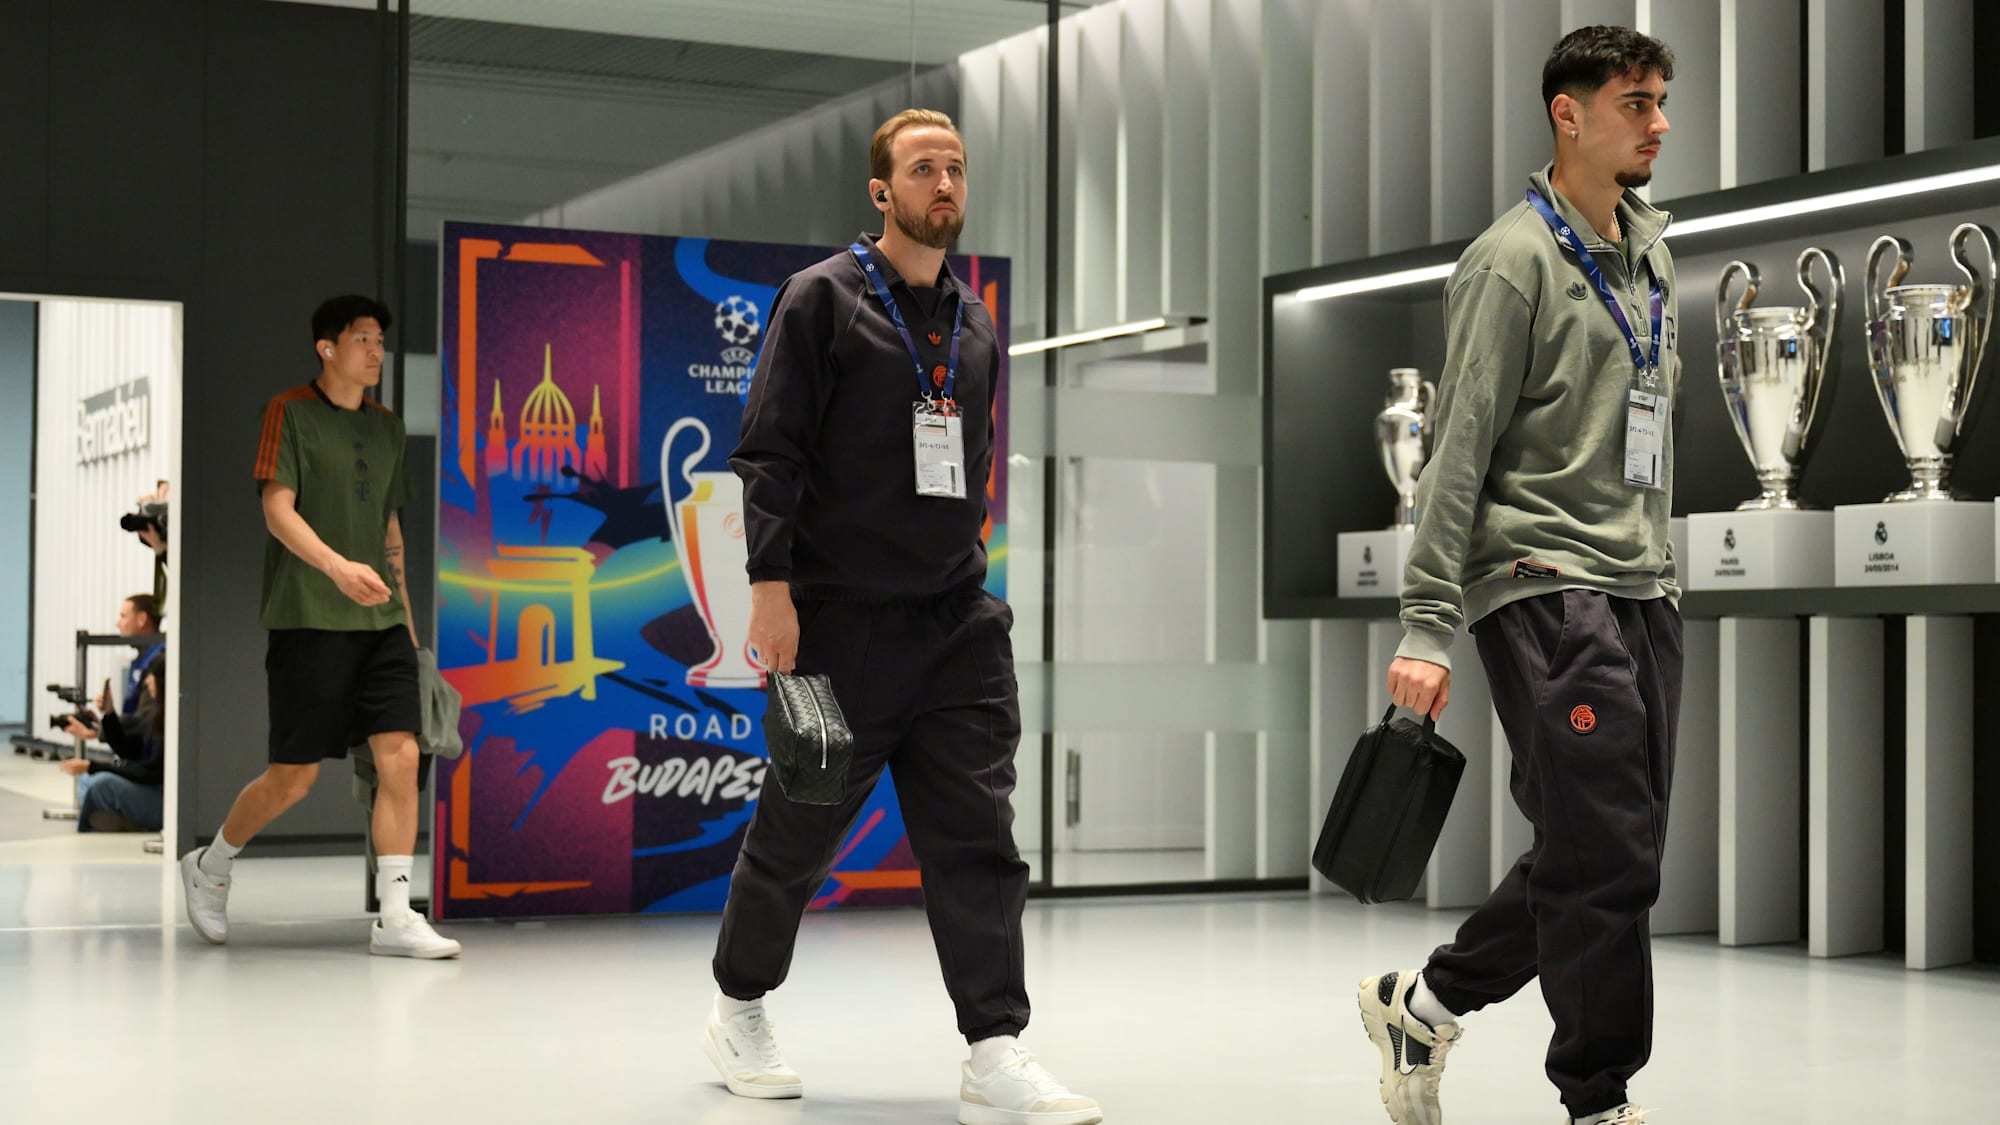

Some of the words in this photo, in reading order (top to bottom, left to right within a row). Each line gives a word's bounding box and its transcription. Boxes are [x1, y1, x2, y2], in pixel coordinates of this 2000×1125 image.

[688, 364, 756, 380] CHAMPI
[705, 380, 752, 395] LEAG
[650, 713, 752, 740] ROAD
